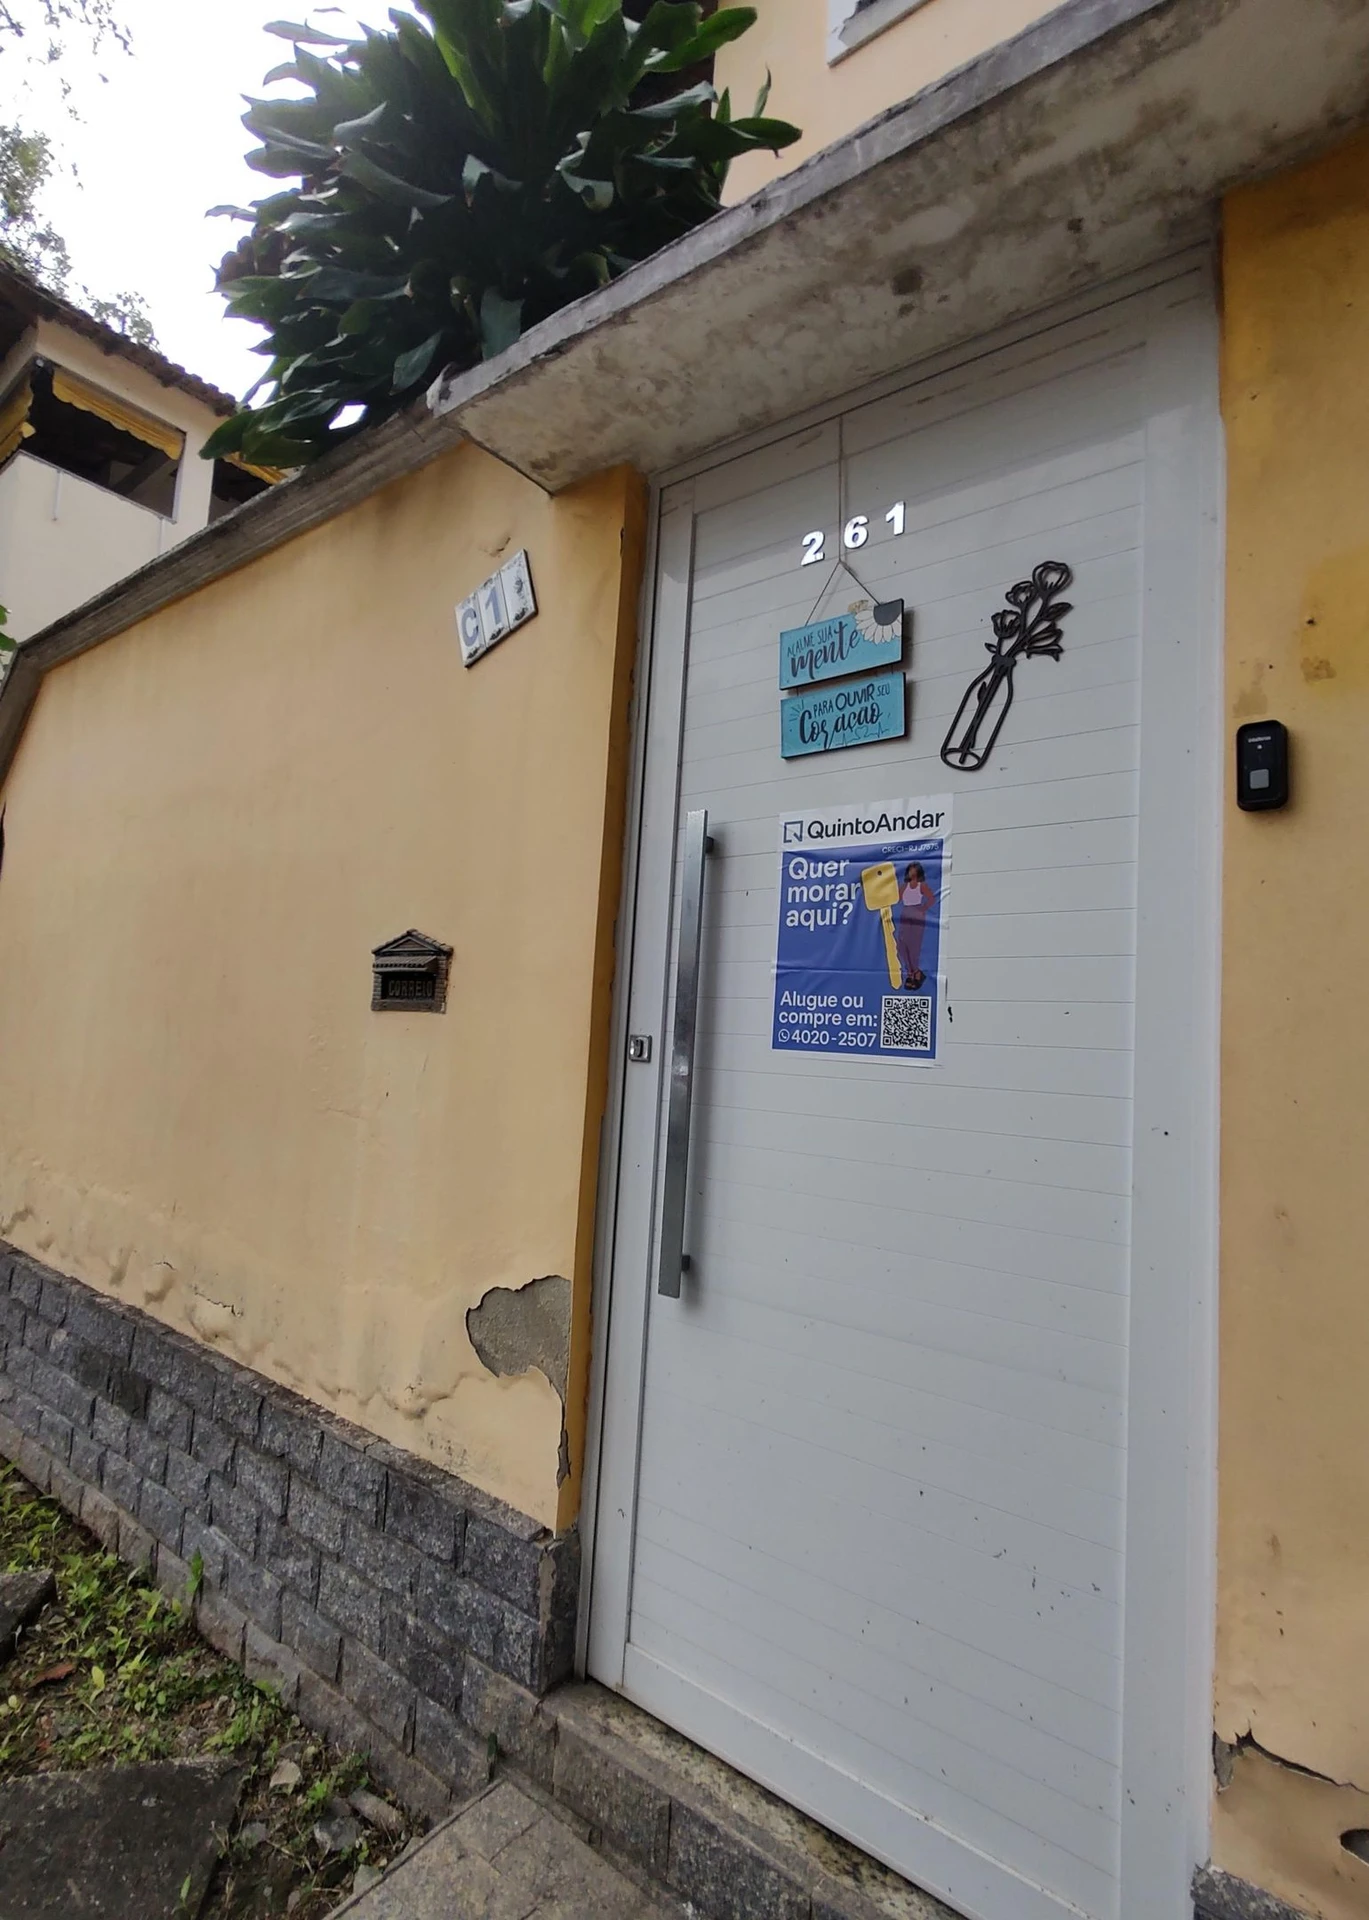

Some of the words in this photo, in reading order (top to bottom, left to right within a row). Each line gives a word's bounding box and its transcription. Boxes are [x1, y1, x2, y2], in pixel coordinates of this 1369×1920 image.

[801, 501, 906, 566] 261
[818, 625, 833, 644] SUA
[791, 621, 860, 680] mente
[813, 700, 834, 718] PARA
[835, 683, 875, 711] OUVIR
[877, 682, 890, 696] SEU
[807, 810, 945, 840] QuintoAndar
[788, 857, 850, 880] Quer
[787, 881, 860, 903] morar
[786, 902, 853, 931] aqui?
[780, 991, 837, 1011] Alugue
[841, 995, 864, 1009] ou
[779, 1011, 842, 1029] compre
[846, 1014, 878, 1027] em:
[791, 1029, 877, 1047] 4020-2507
